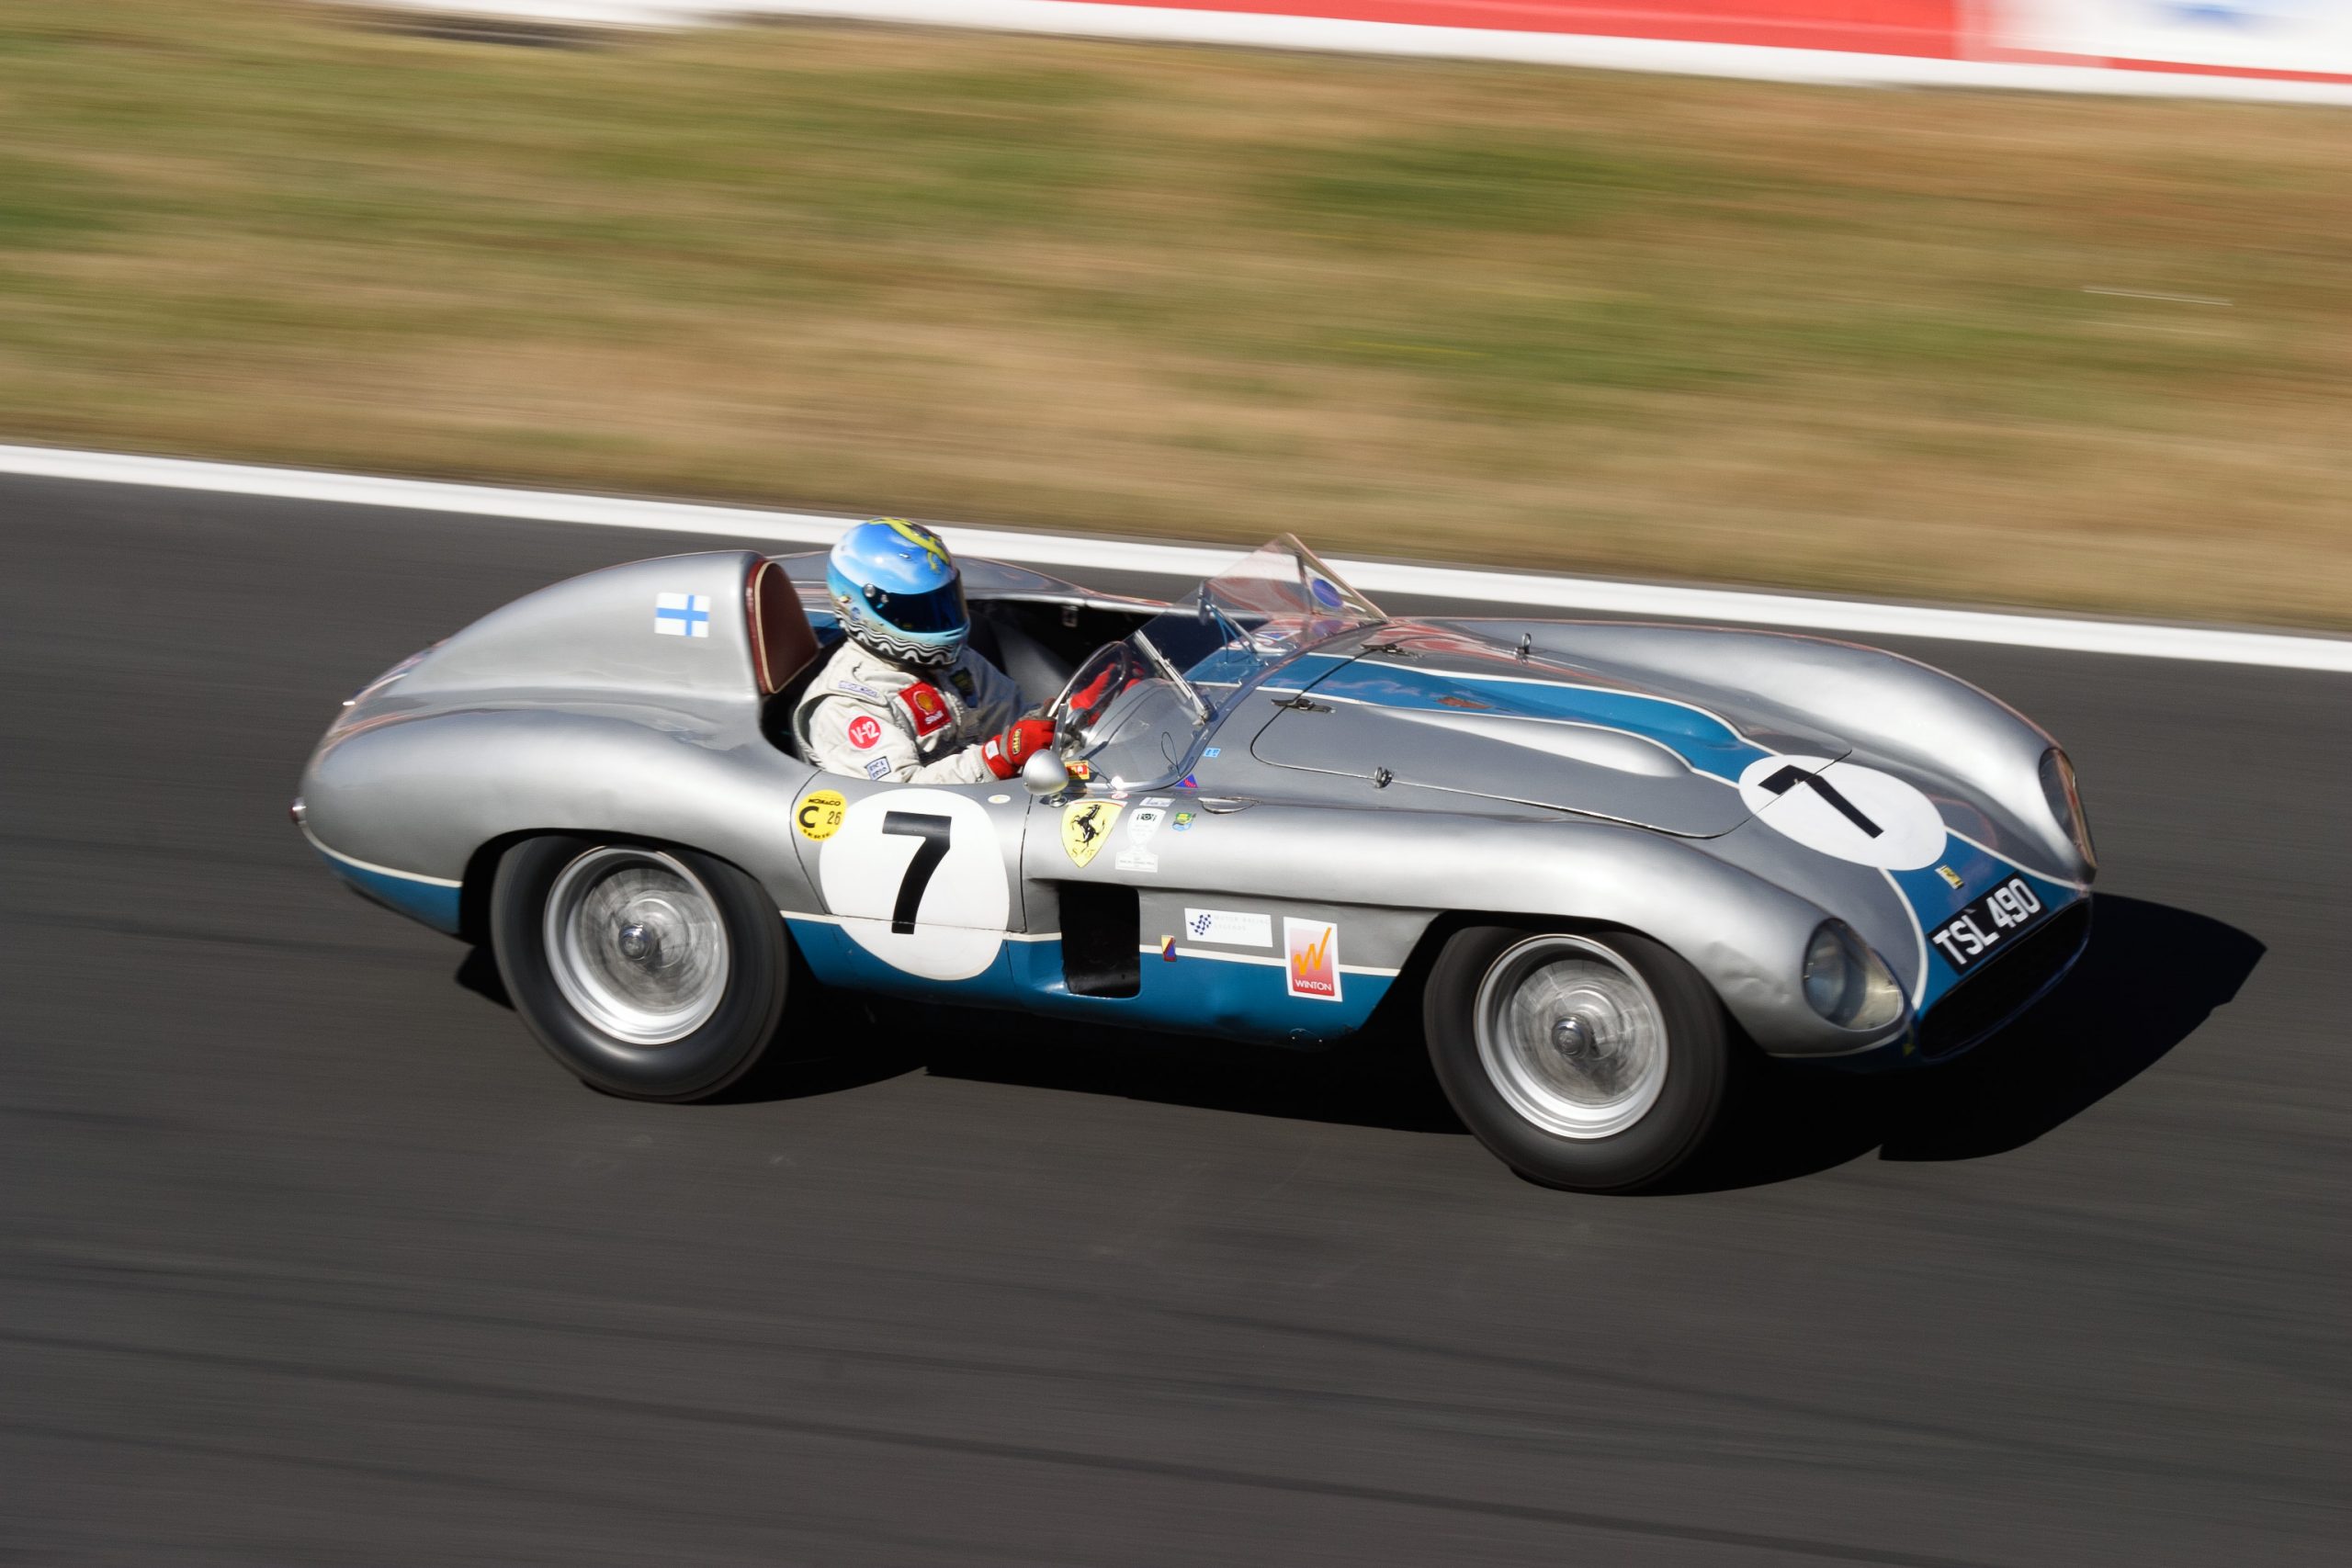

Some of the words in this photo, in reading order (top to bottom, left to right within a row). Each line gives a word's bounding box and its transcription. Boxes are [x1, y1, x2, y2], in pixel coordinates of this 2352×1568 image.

[851, 720, 879, 744] V-12
[798, 805, 820, 829] C
[826, 810, 842, 826] 26
[1758, 764, 1883, 839] 7
[882, 810, 952, 935] 7
[1932, 914, 2001, 965] TSL
[1985, 877, 2041, 929] 490
[1294, 978, 1333, 992] WINTON
